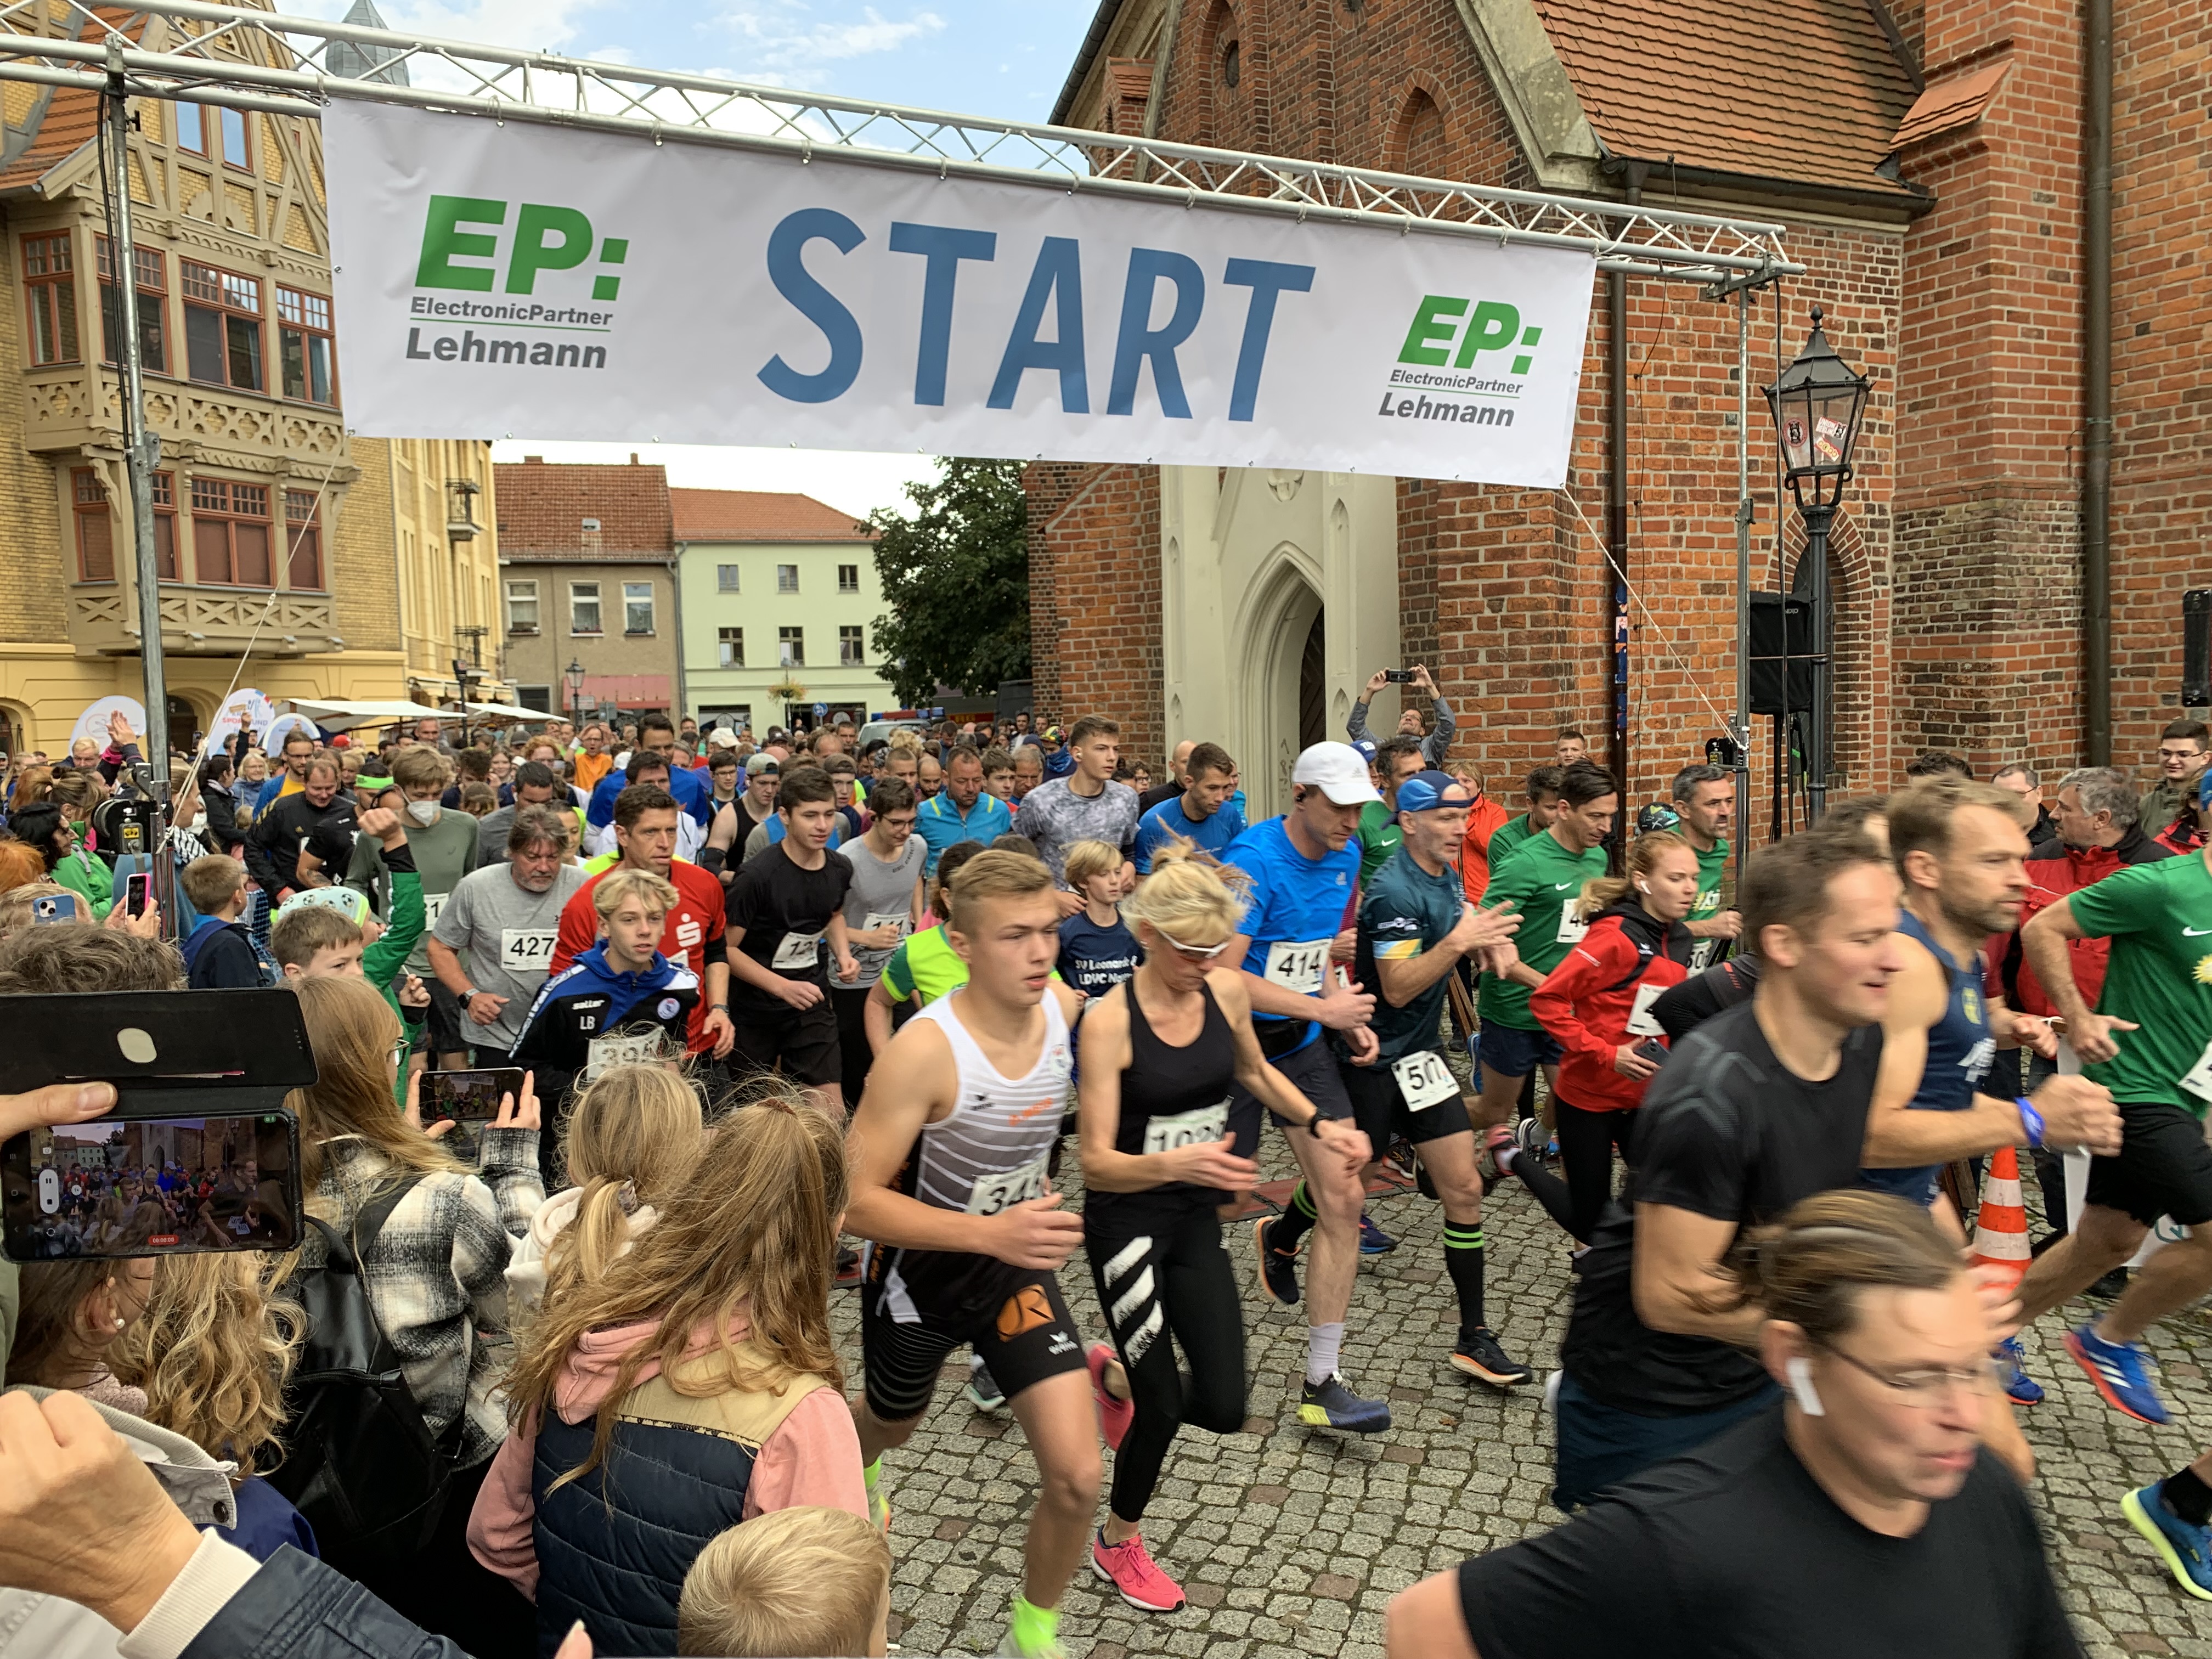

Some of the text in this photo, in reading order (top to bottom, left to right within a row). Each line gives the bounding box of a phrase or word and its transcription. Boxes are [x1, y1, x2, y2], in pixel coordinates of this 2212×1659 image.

[415, 195, 629, 302] EP:
[410, 297, 613, 326] ElectronicPartner
[757, 207, 1316, 422] START
[406, 328, 607, 369] Lehmann
[1397, 295, 1543, 375] EP:
[1389, 369, 1523, 394] ElectronicPartner
[1378, 392, 1515, 427] Lehmann
[510, 936, 555, 956] 427
[1277, 949, 1321, 977] 414
[579, 1015, 595, 1030] LB
